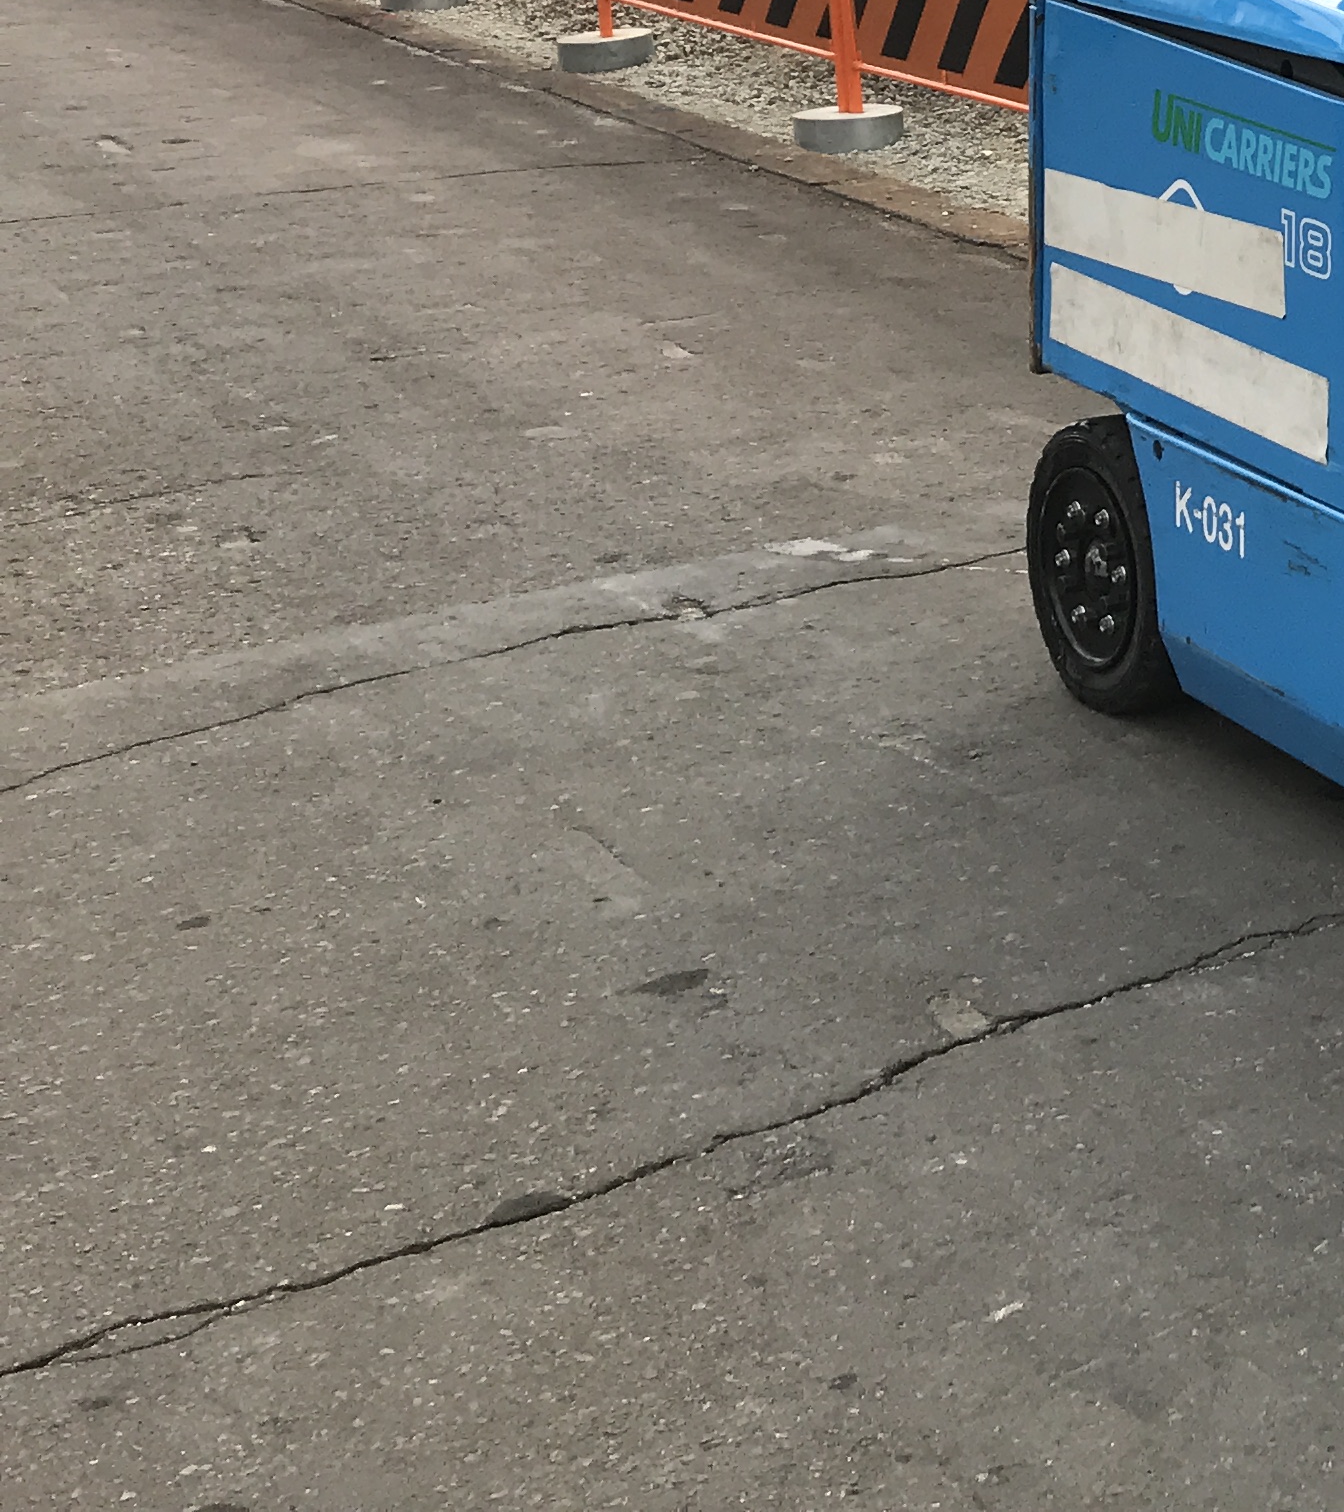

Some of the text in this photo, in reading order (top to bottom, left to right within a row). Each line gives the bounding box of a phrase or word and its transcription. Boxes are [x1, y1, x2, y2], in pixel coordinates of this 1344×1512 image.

[1152, 89, 1334, 200] UNICARRIERS
[1281, 207, 1332, 280] 18
[1175, 480, 1245, 560] K-031
